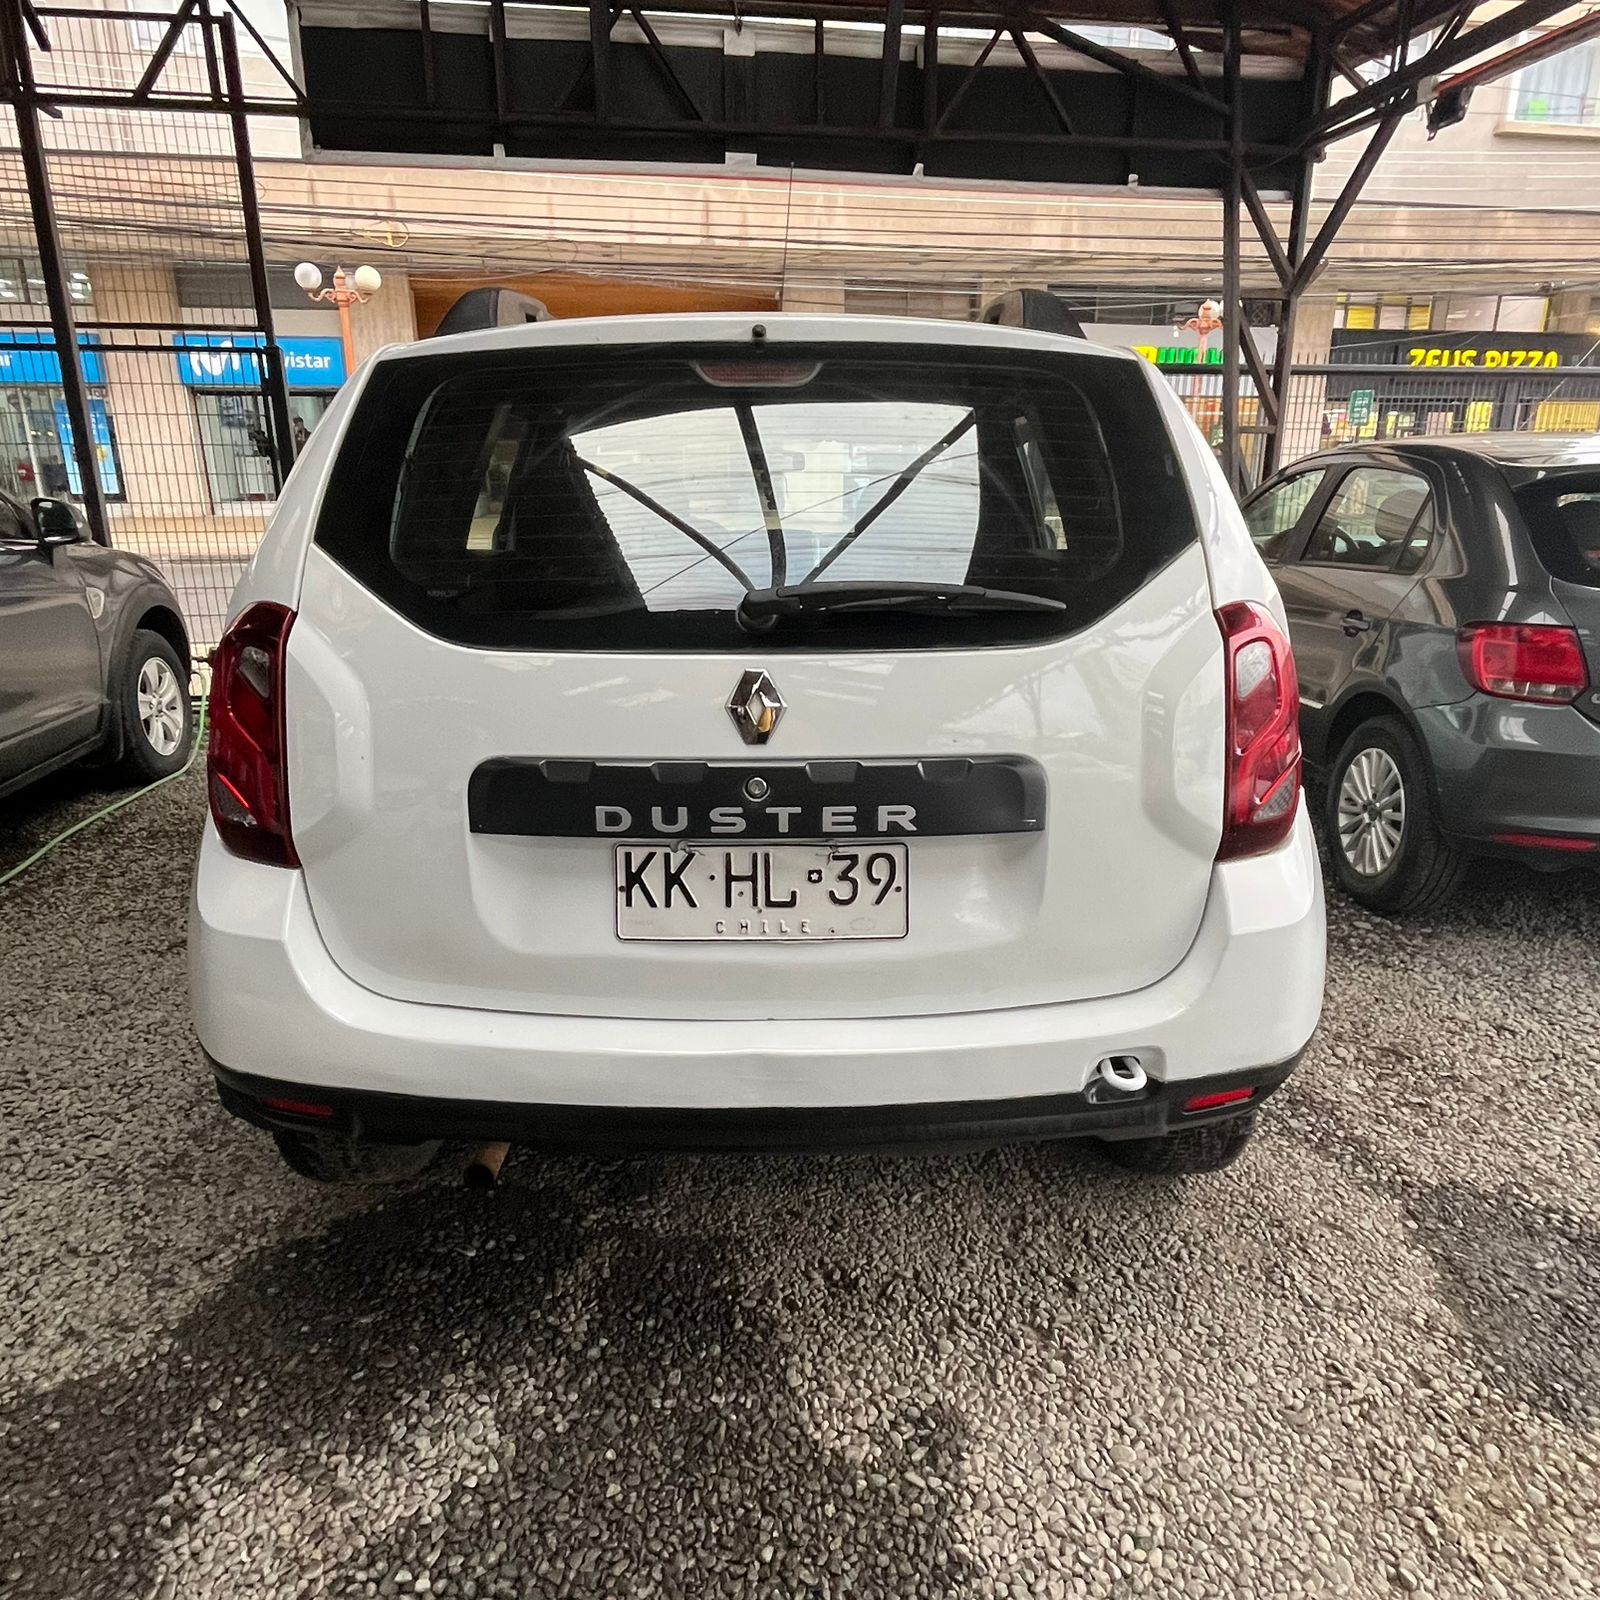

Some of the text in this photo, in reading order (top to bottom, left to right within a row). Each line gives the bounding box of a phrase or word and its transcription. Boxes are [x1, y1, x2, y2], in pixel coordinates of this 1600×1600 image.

[1409, 348, 1559, 368] ZEUS PIZZA
[595, 804, 917, 834] DUSTER
[715, 920, 812, 934] CHILE
